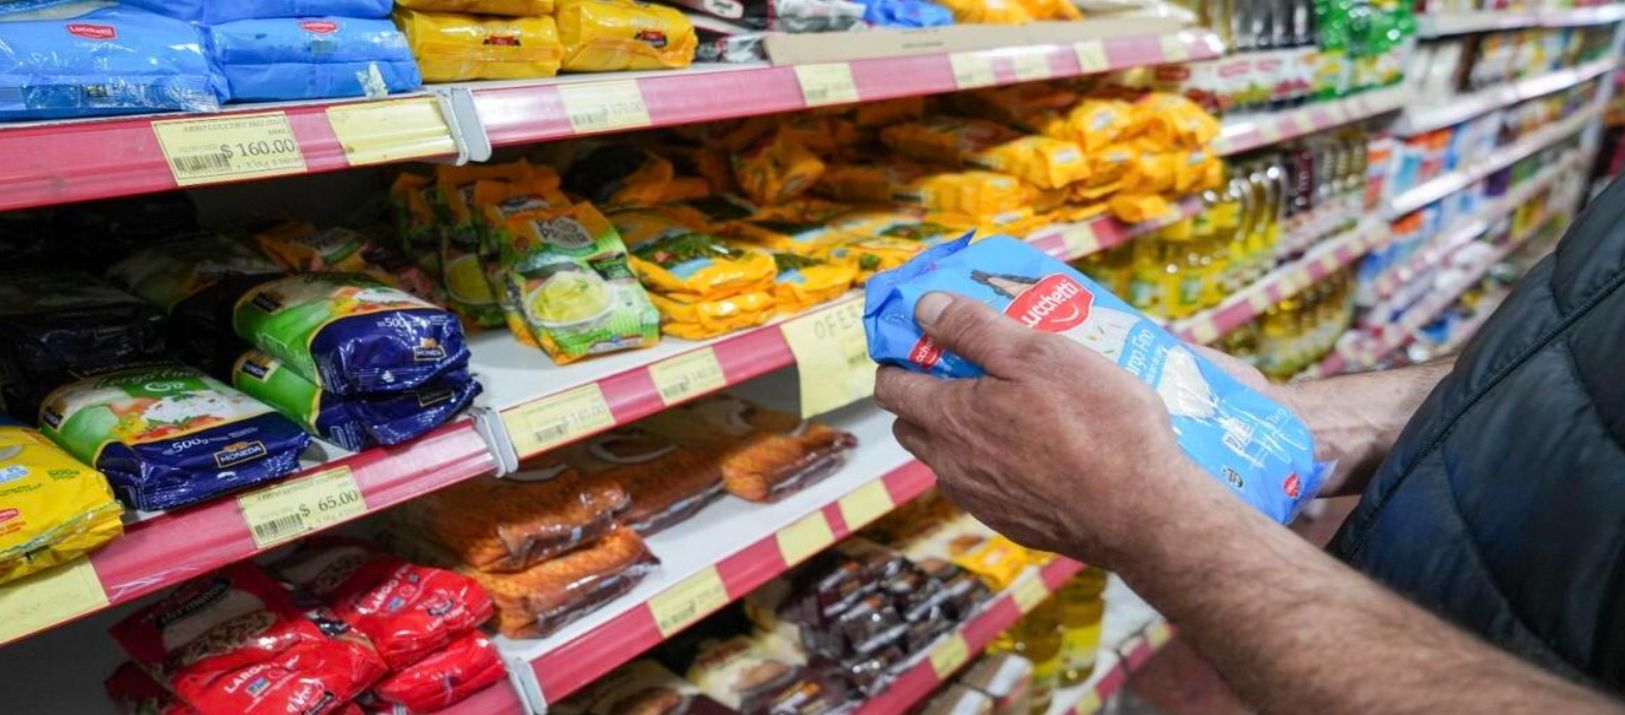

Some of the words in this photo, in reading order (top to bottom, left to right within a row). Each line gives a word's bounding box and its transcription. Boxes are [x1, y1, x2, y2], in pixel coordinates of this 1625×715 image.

[220, 143, 234, 161] $
[236, 138, 296, 157] 160.00
[1021, 278, 1080, 328] ucchetti
[220, 445, 262, 463] MONEDA
[299, 503, 311, 519] $
[318, 489, 359, 512] 65.00
